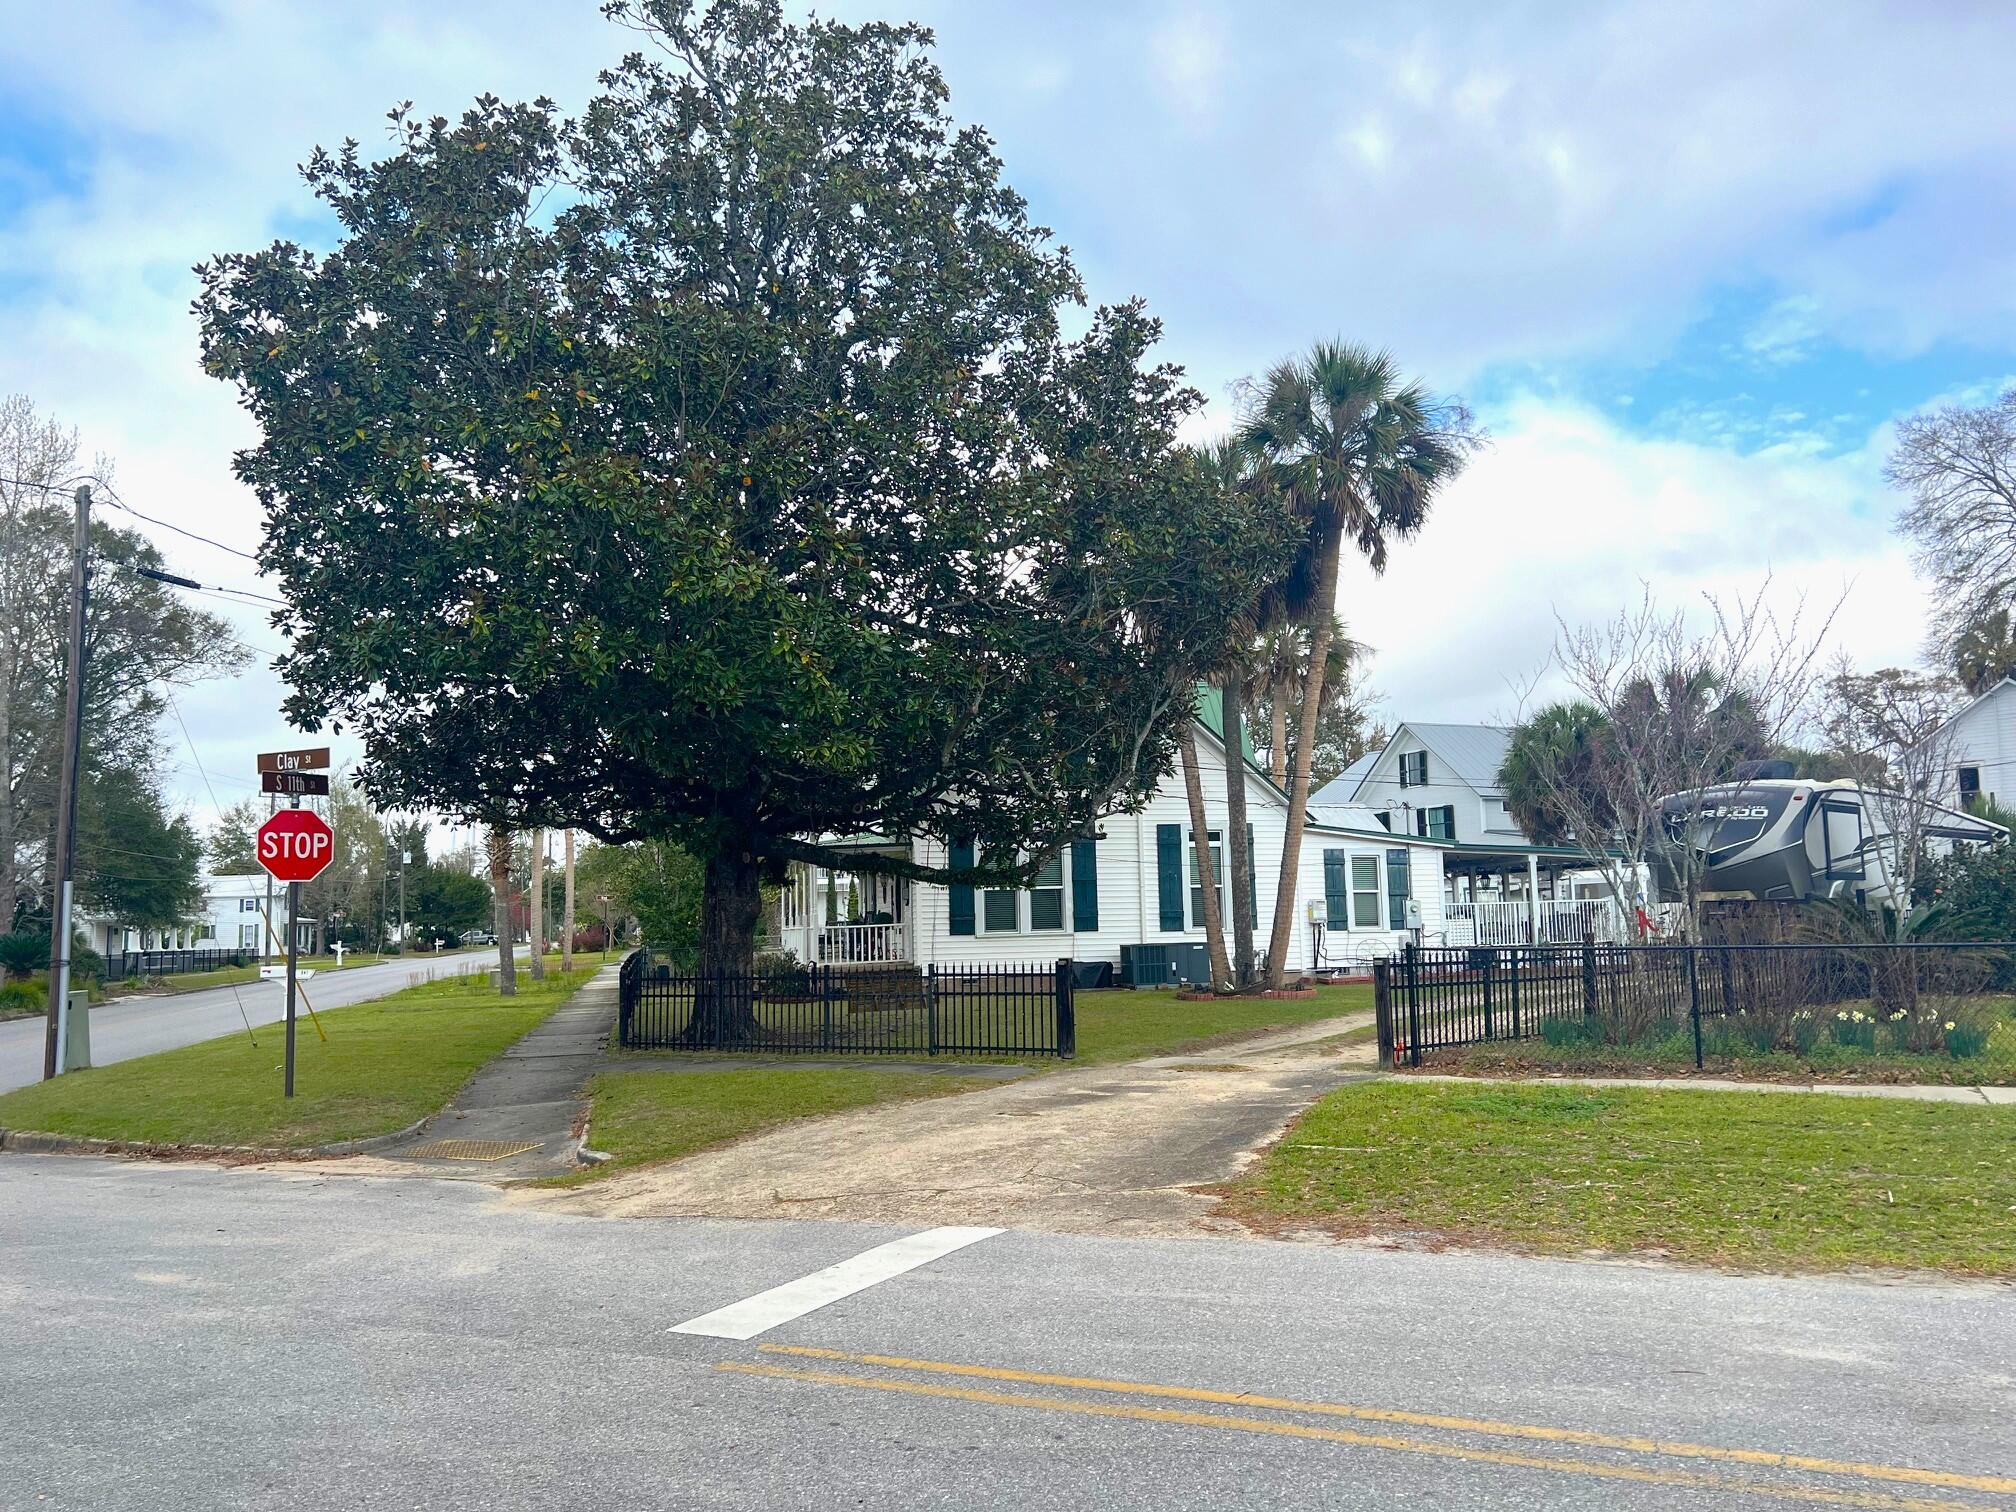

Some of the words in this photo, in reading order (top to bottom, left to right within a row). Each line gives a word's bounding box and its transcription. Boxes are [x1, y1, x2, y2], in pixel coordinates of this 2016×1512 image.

[277, 754, 300, 770] Clay
[305, 755, 312, 764] St
[276, 775, 282, 791] S
[288, 776, 306, 792] 11th
[261, 831, 329, 859] STOP
